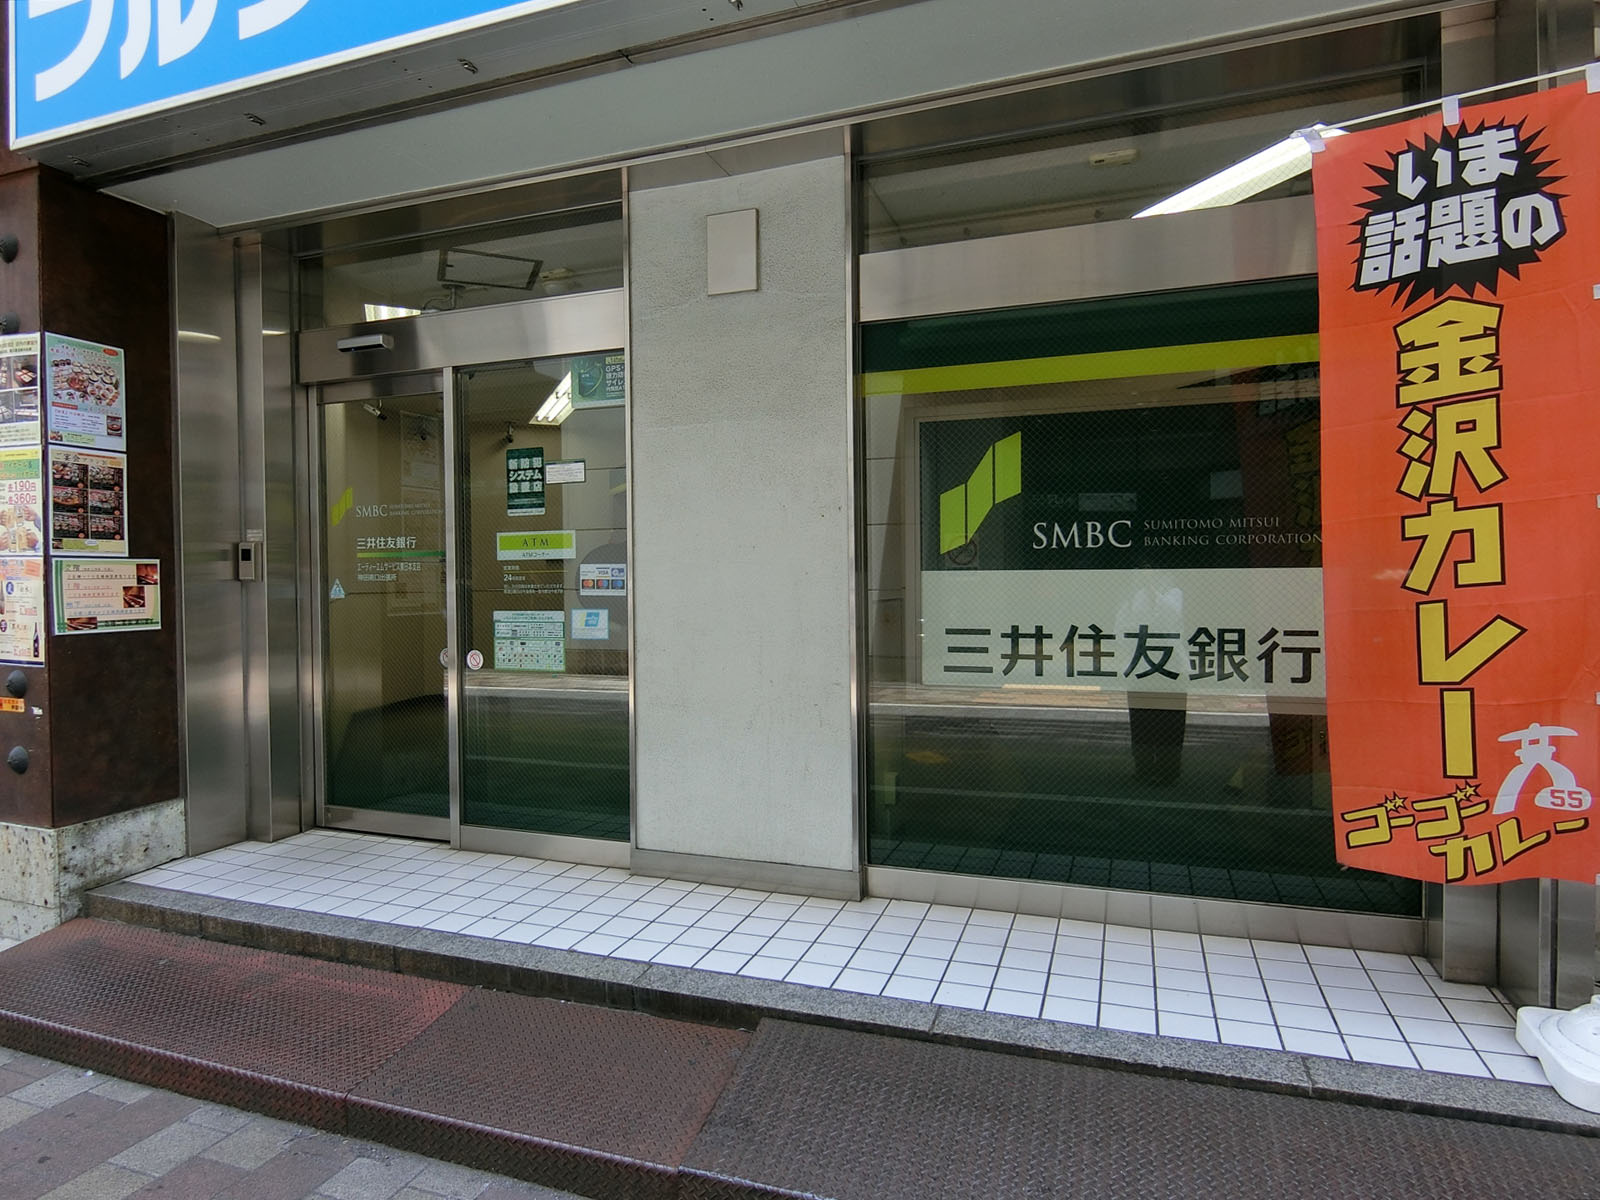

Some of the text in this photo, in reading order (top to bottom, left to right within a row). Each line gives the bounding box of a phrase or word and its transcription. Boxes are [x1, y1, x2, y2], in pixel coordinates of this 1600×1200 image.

[1397, 128, 1519, 200] いま
[1360, 188, 1560, 285] 話題の
[508, 469, 543, 481] システム
[356, 504, 388, 517] SMBC
[357, 536, 417, 549] 三井住友銀行
[522, 538, 549, 547] ATM
[1032, 517, 1280, 550] SMBC SUMITOMO MITSUI
[1144, 533, 1322, 546] BANKING CORPORATION
[1394, 297, 1527, 779] 金沢カレー
[943, 624, 1321, 684] 三井住友銀行
[1341, 780, 1490, 849] ゴーゴー
[1550, 789, 1583, 809] 55
[1428, 816, 1589, 884] カレー
